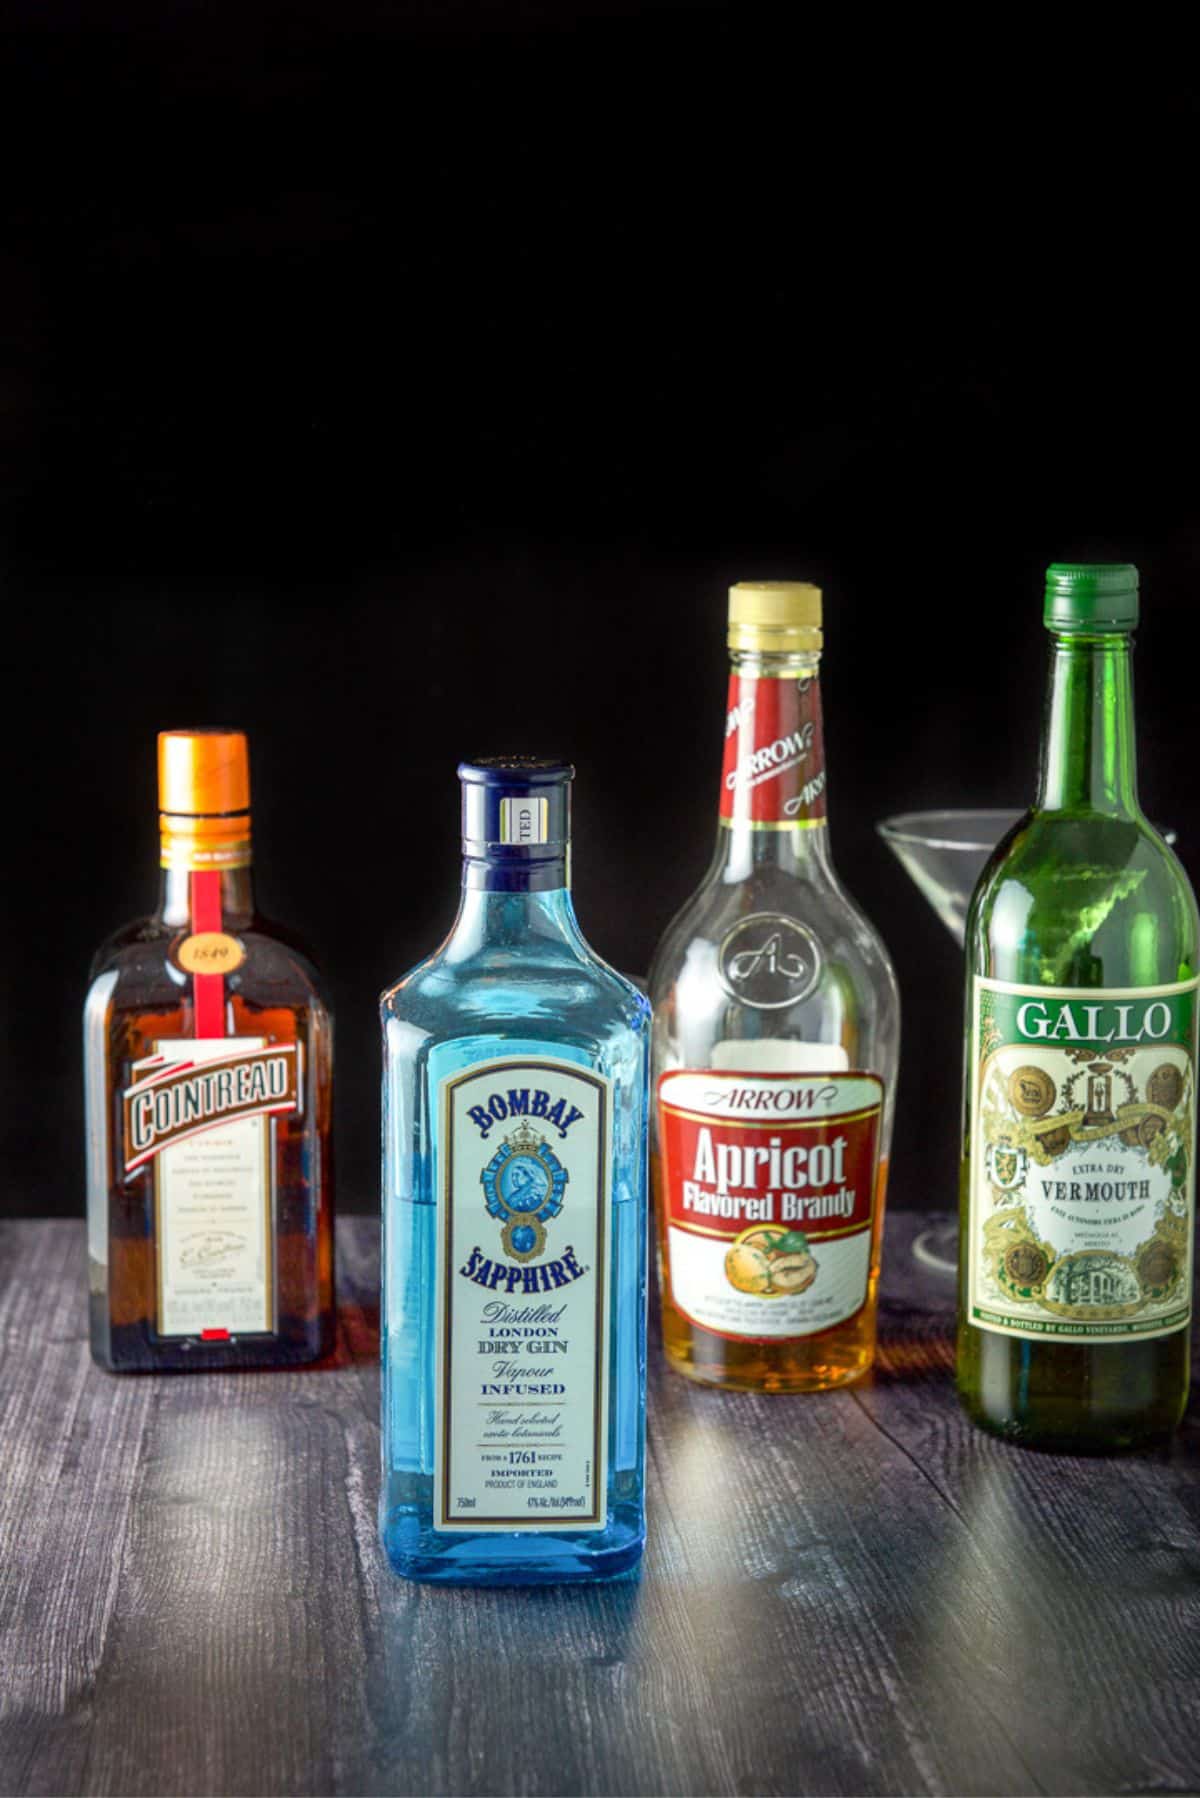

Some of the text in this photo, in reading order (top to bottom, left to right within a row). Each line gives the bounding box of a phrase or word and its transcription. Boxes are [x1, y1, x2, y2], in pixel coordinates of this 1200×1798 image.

[1016, 1002, 1172, 1042] GALLO
[133, 1058, 287, 1149] COINTREAU
[704, 1085, 840, 1112] ARROW
[466, 1088, 585, 1139] BOMBAY
[693, 1127, 848, 1194] Apricot
[682, 1180, 857, 1221] Flavored Brandy
[1041, 1179, 1151, 1202] VERMOUTH
[459, 1246, 585, 1294] SAPPHIRE
[480, 1301, 568, 1324] Distilled
[488, 1327, 559, 1338] LONDON
[477, 1341, 569, 1354] DRY GIN
[492, 1360, 555, 1383] Vapour
[481, 1384, 566, 1395] INFUSED
[509, 1451, 536, 1464] 1761
[484, 1479, 515, 1489] PRODUCT
[527, 1479, 559, 1489] ENGLAND
[491, 1469, 553, 1478] IMPORTED
